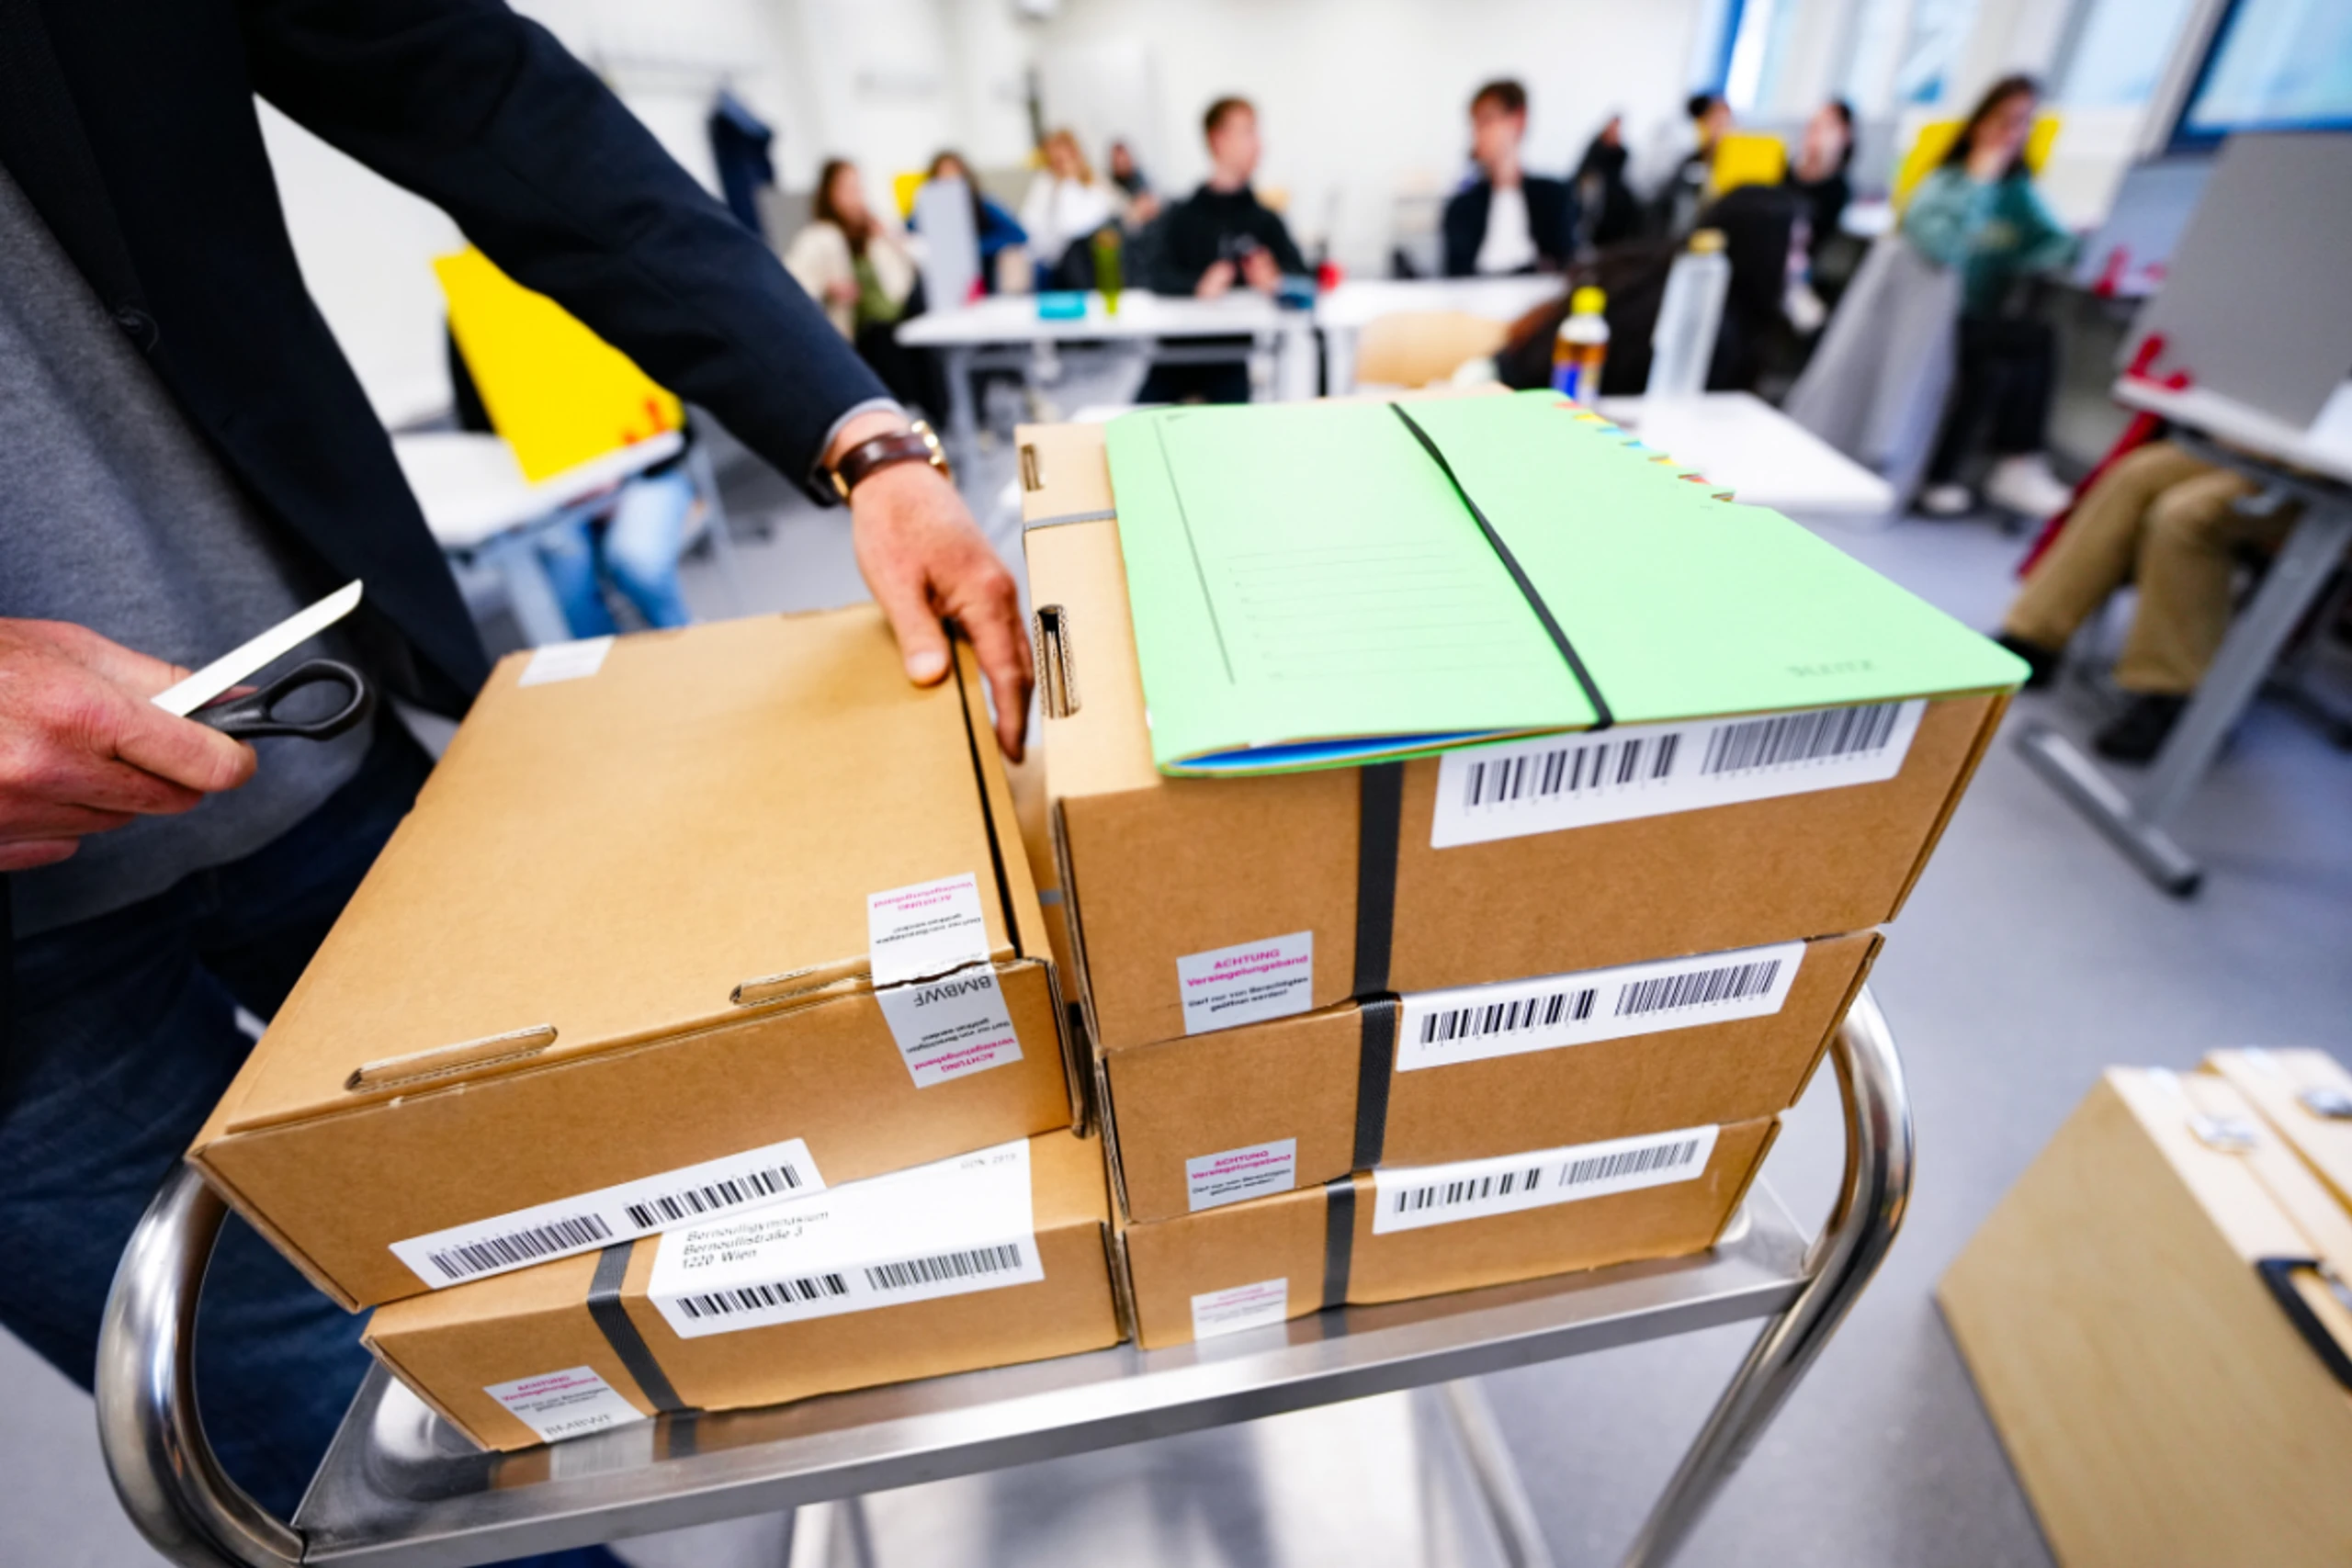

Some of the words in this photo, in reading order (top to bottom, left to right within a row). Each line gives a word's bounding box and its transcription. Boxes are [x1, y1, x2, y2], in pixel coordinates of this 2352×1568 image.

[1187, 955, 1308, 987] Versiegelungsband
[1214, 948, 1281, 970] ACHTUNG
[913, 976, 992, 1009] BMBWF
[683, 1255, 714, 1269] 1220
[721, 1249, 757, 1262] Wien
